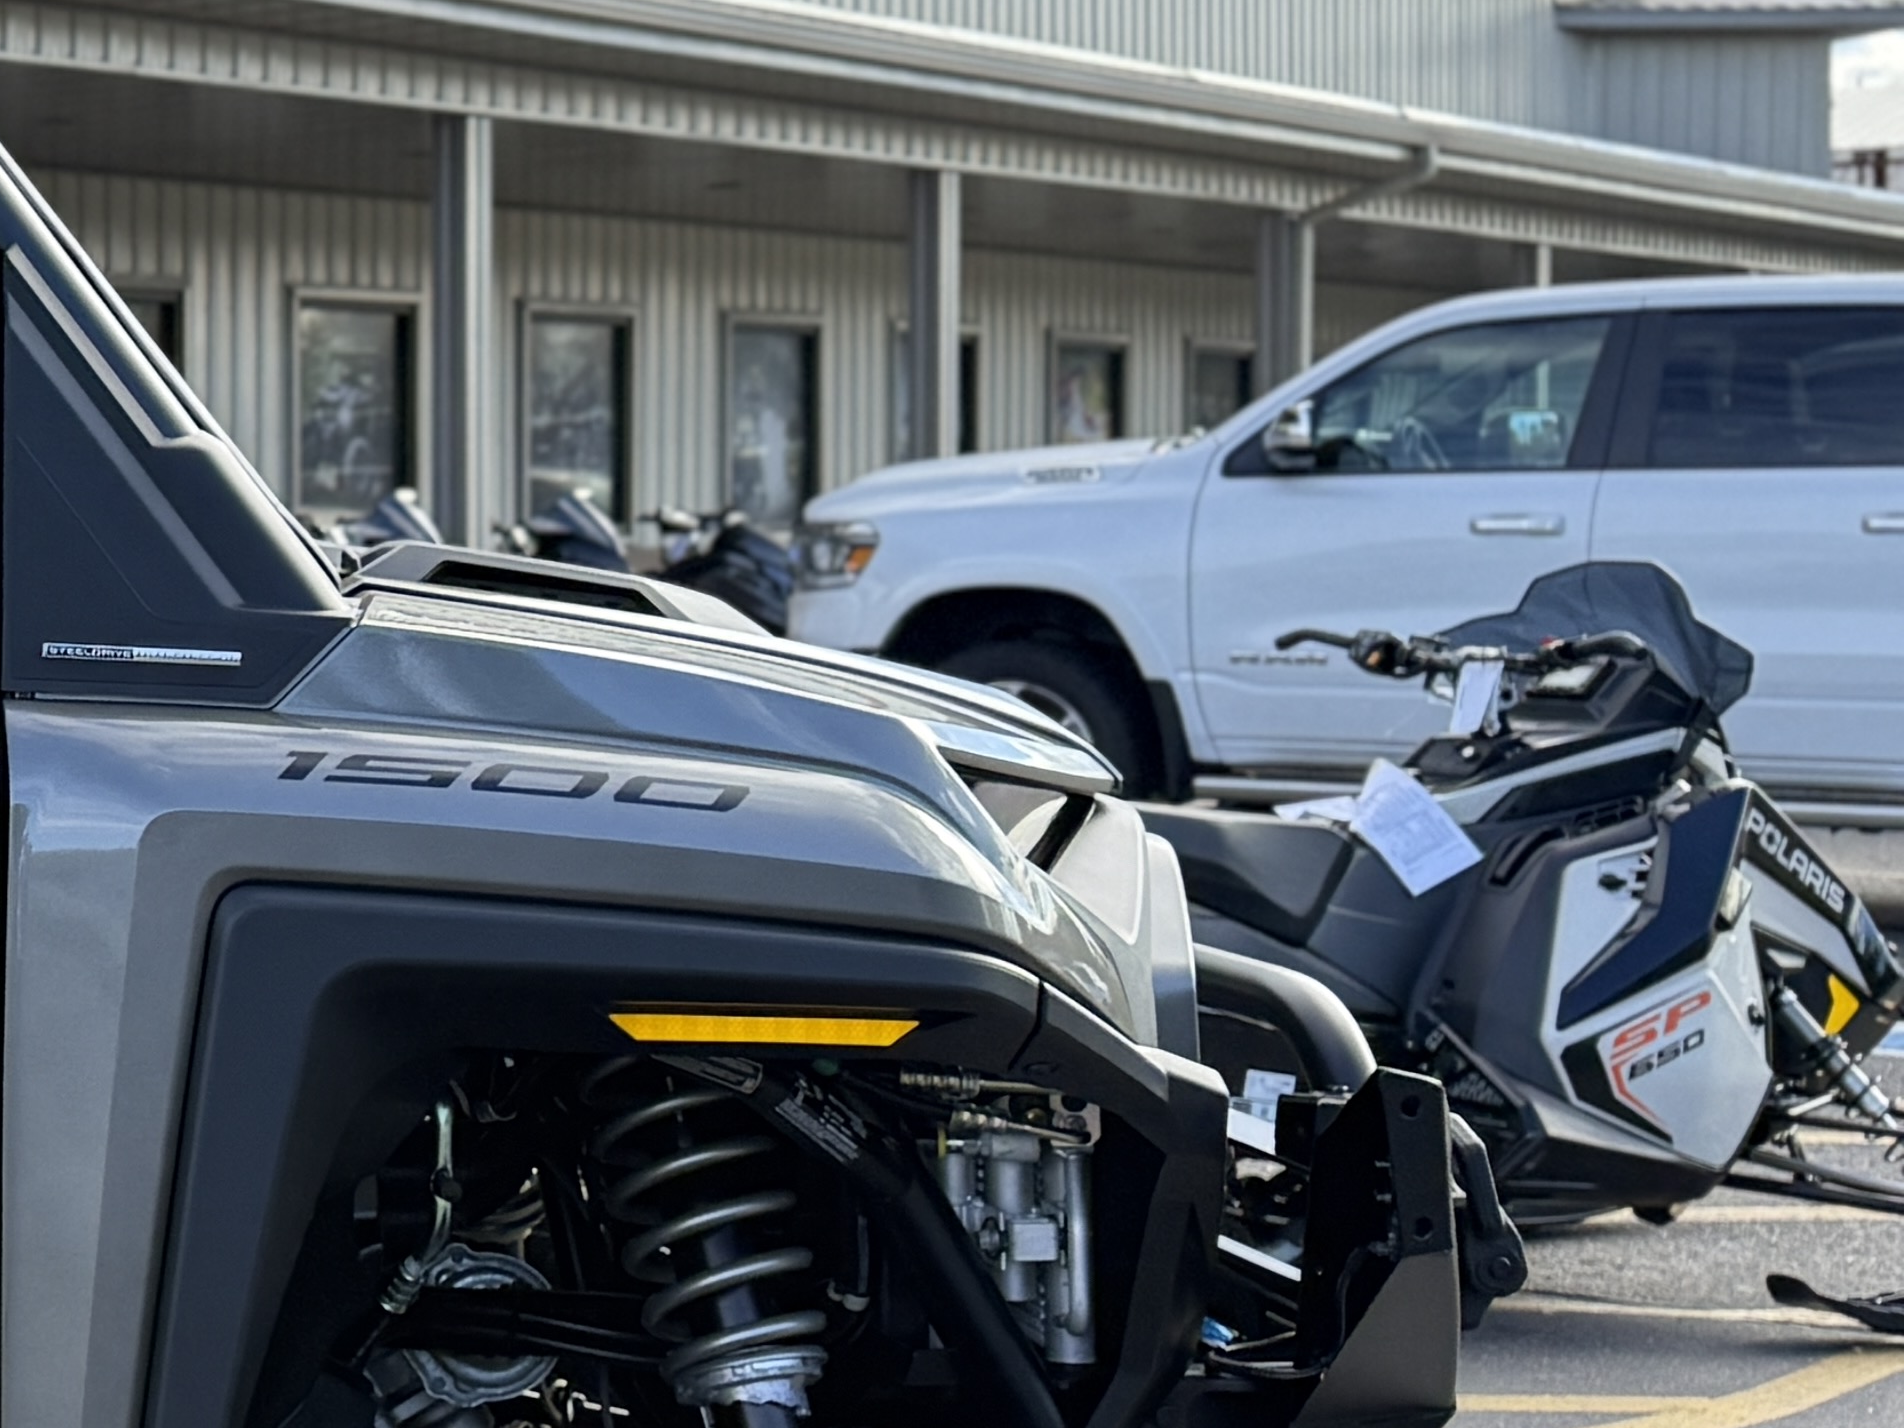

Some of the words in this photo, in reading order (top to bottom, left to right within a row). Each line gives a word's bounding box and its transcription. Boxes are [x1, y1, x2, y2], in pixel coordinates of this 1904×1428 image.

[278, 749, 751, 813] 1500
[1744, 807, 1847, 914] POLARIS
[1611, 990, 1712, 1059] SP
